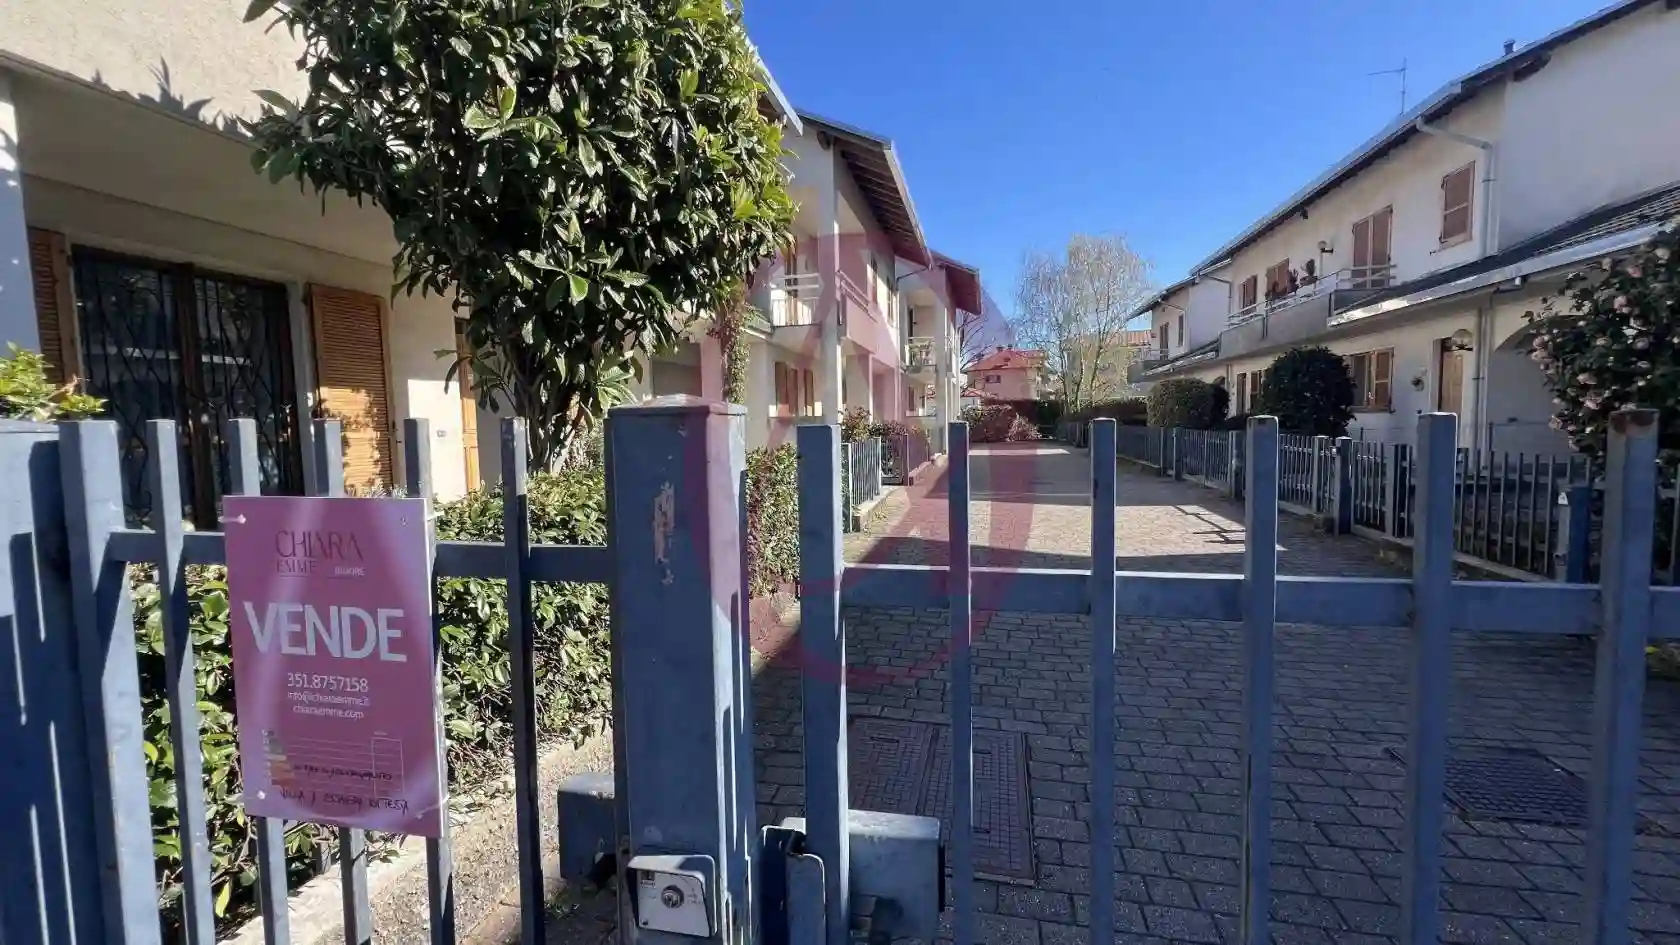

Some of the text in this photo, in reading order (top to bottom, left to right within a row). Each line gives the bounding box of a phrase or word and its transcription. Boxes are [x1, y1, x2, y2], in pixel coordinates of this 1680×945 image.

[275, 529, 364, 562] CHIARA
[243, 600, 407, 663] VENDE
[287, 672, 369, 693] 351.8757158
